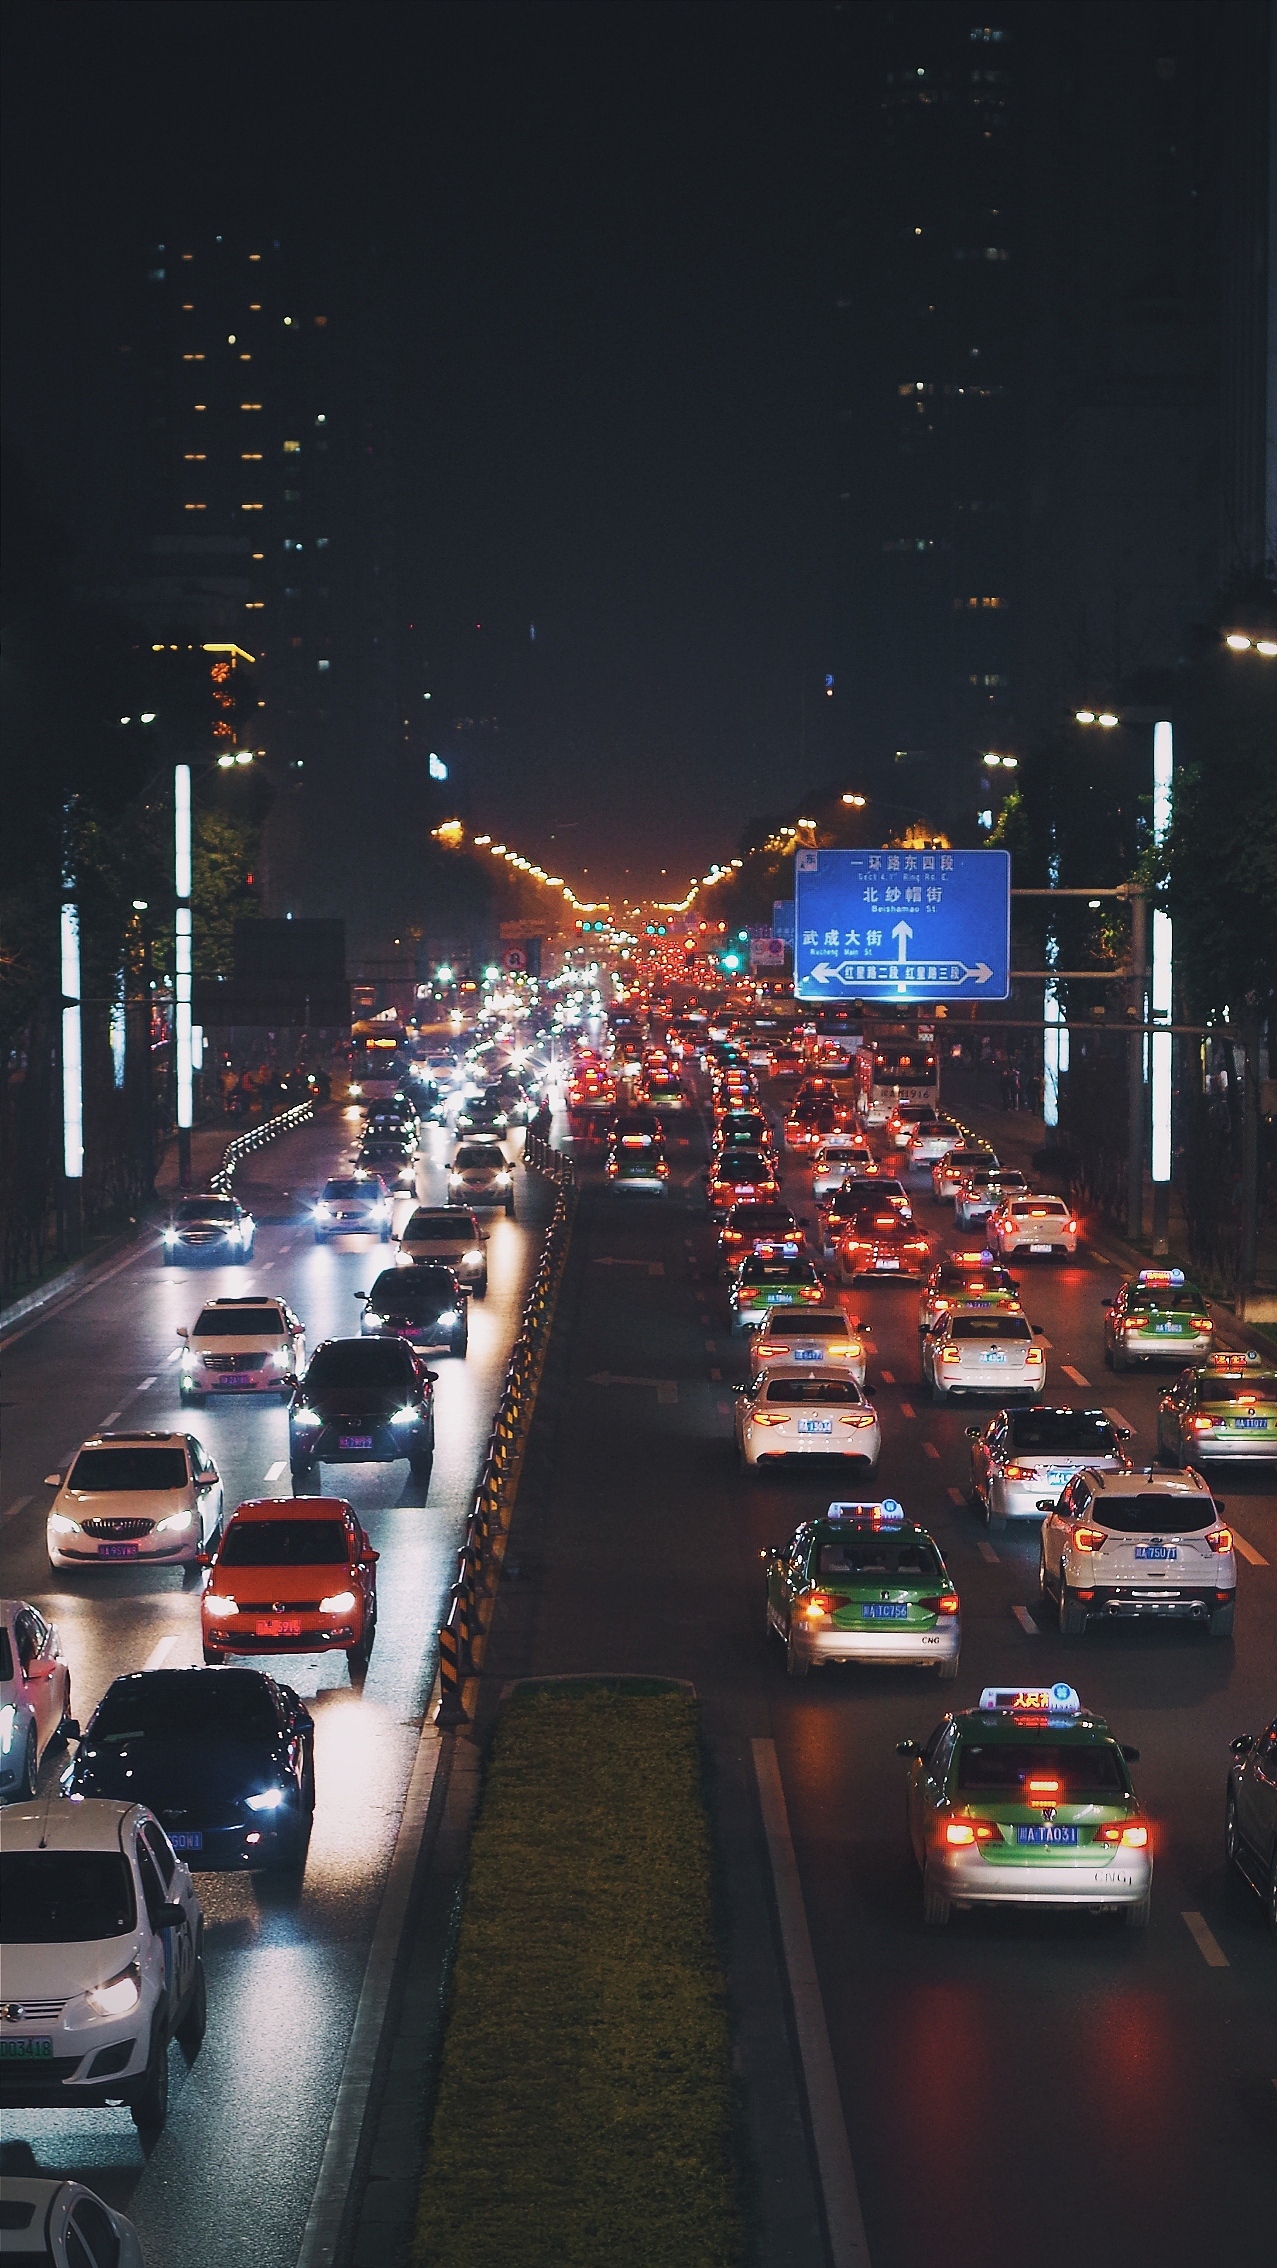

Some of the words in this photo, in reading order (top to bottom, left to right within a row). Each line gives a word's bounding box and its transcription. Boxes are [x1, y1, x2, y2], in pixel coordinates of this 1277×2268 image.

[851, 854, 954, 871] 一环路东四段
[863, 886, 942, 903] 北纱帽街
[871, 905, 920, 913] Beishamao
[802, 929, 883, 947] 武成大街
[845, 965, 899, 980] 红星路二段
[905, 965, 960, 980] 红星路三段
[921, 1636, 940, 1644] CNG
